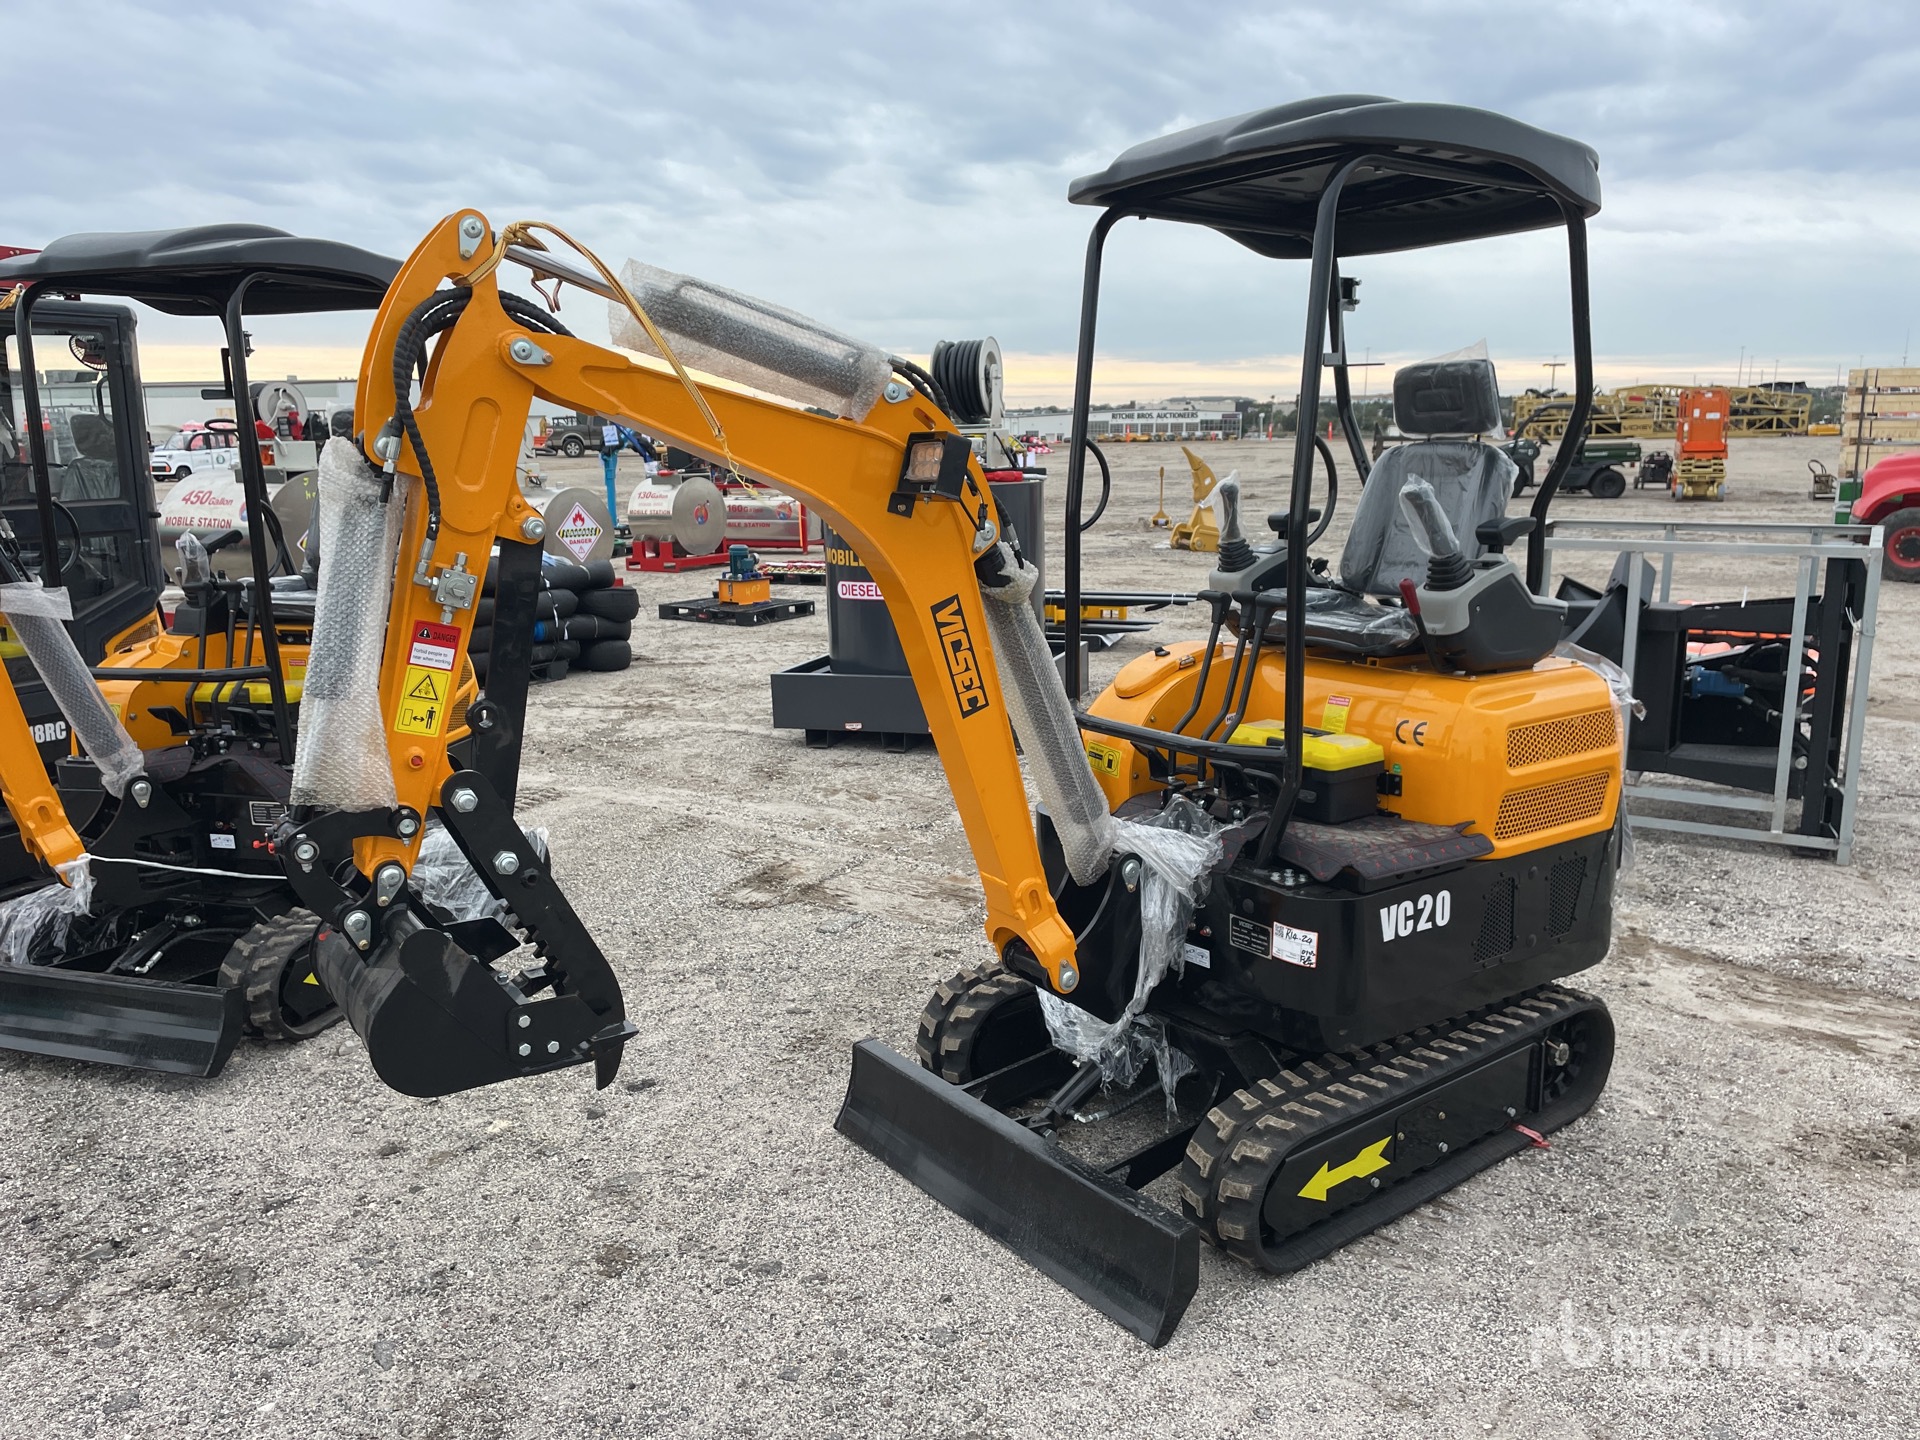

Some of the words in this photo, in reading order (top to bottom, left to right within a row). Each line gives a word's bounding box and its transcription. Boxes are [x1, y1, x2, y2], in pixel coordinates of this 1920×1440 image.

[1111, 412, 1135, 420] RITCHIE
[1156, 411, 1199, 419] AUCTIONEERS
[182, 490, 212, 505] 450
[208, 496, 234, 506] Gallon
[637, 491, 652, 499] 130
[164, 516, 196, 527] MOBILE
[197, 516, 233, 529] STATION
[432, 632, 456, 643] DANGER
[414, 647, 428, 655] Forbid
[934, 597, 987, 713] VICSEC
[435, 658, 451, 666] working
[1379, 889, 1451, 943] VC20
